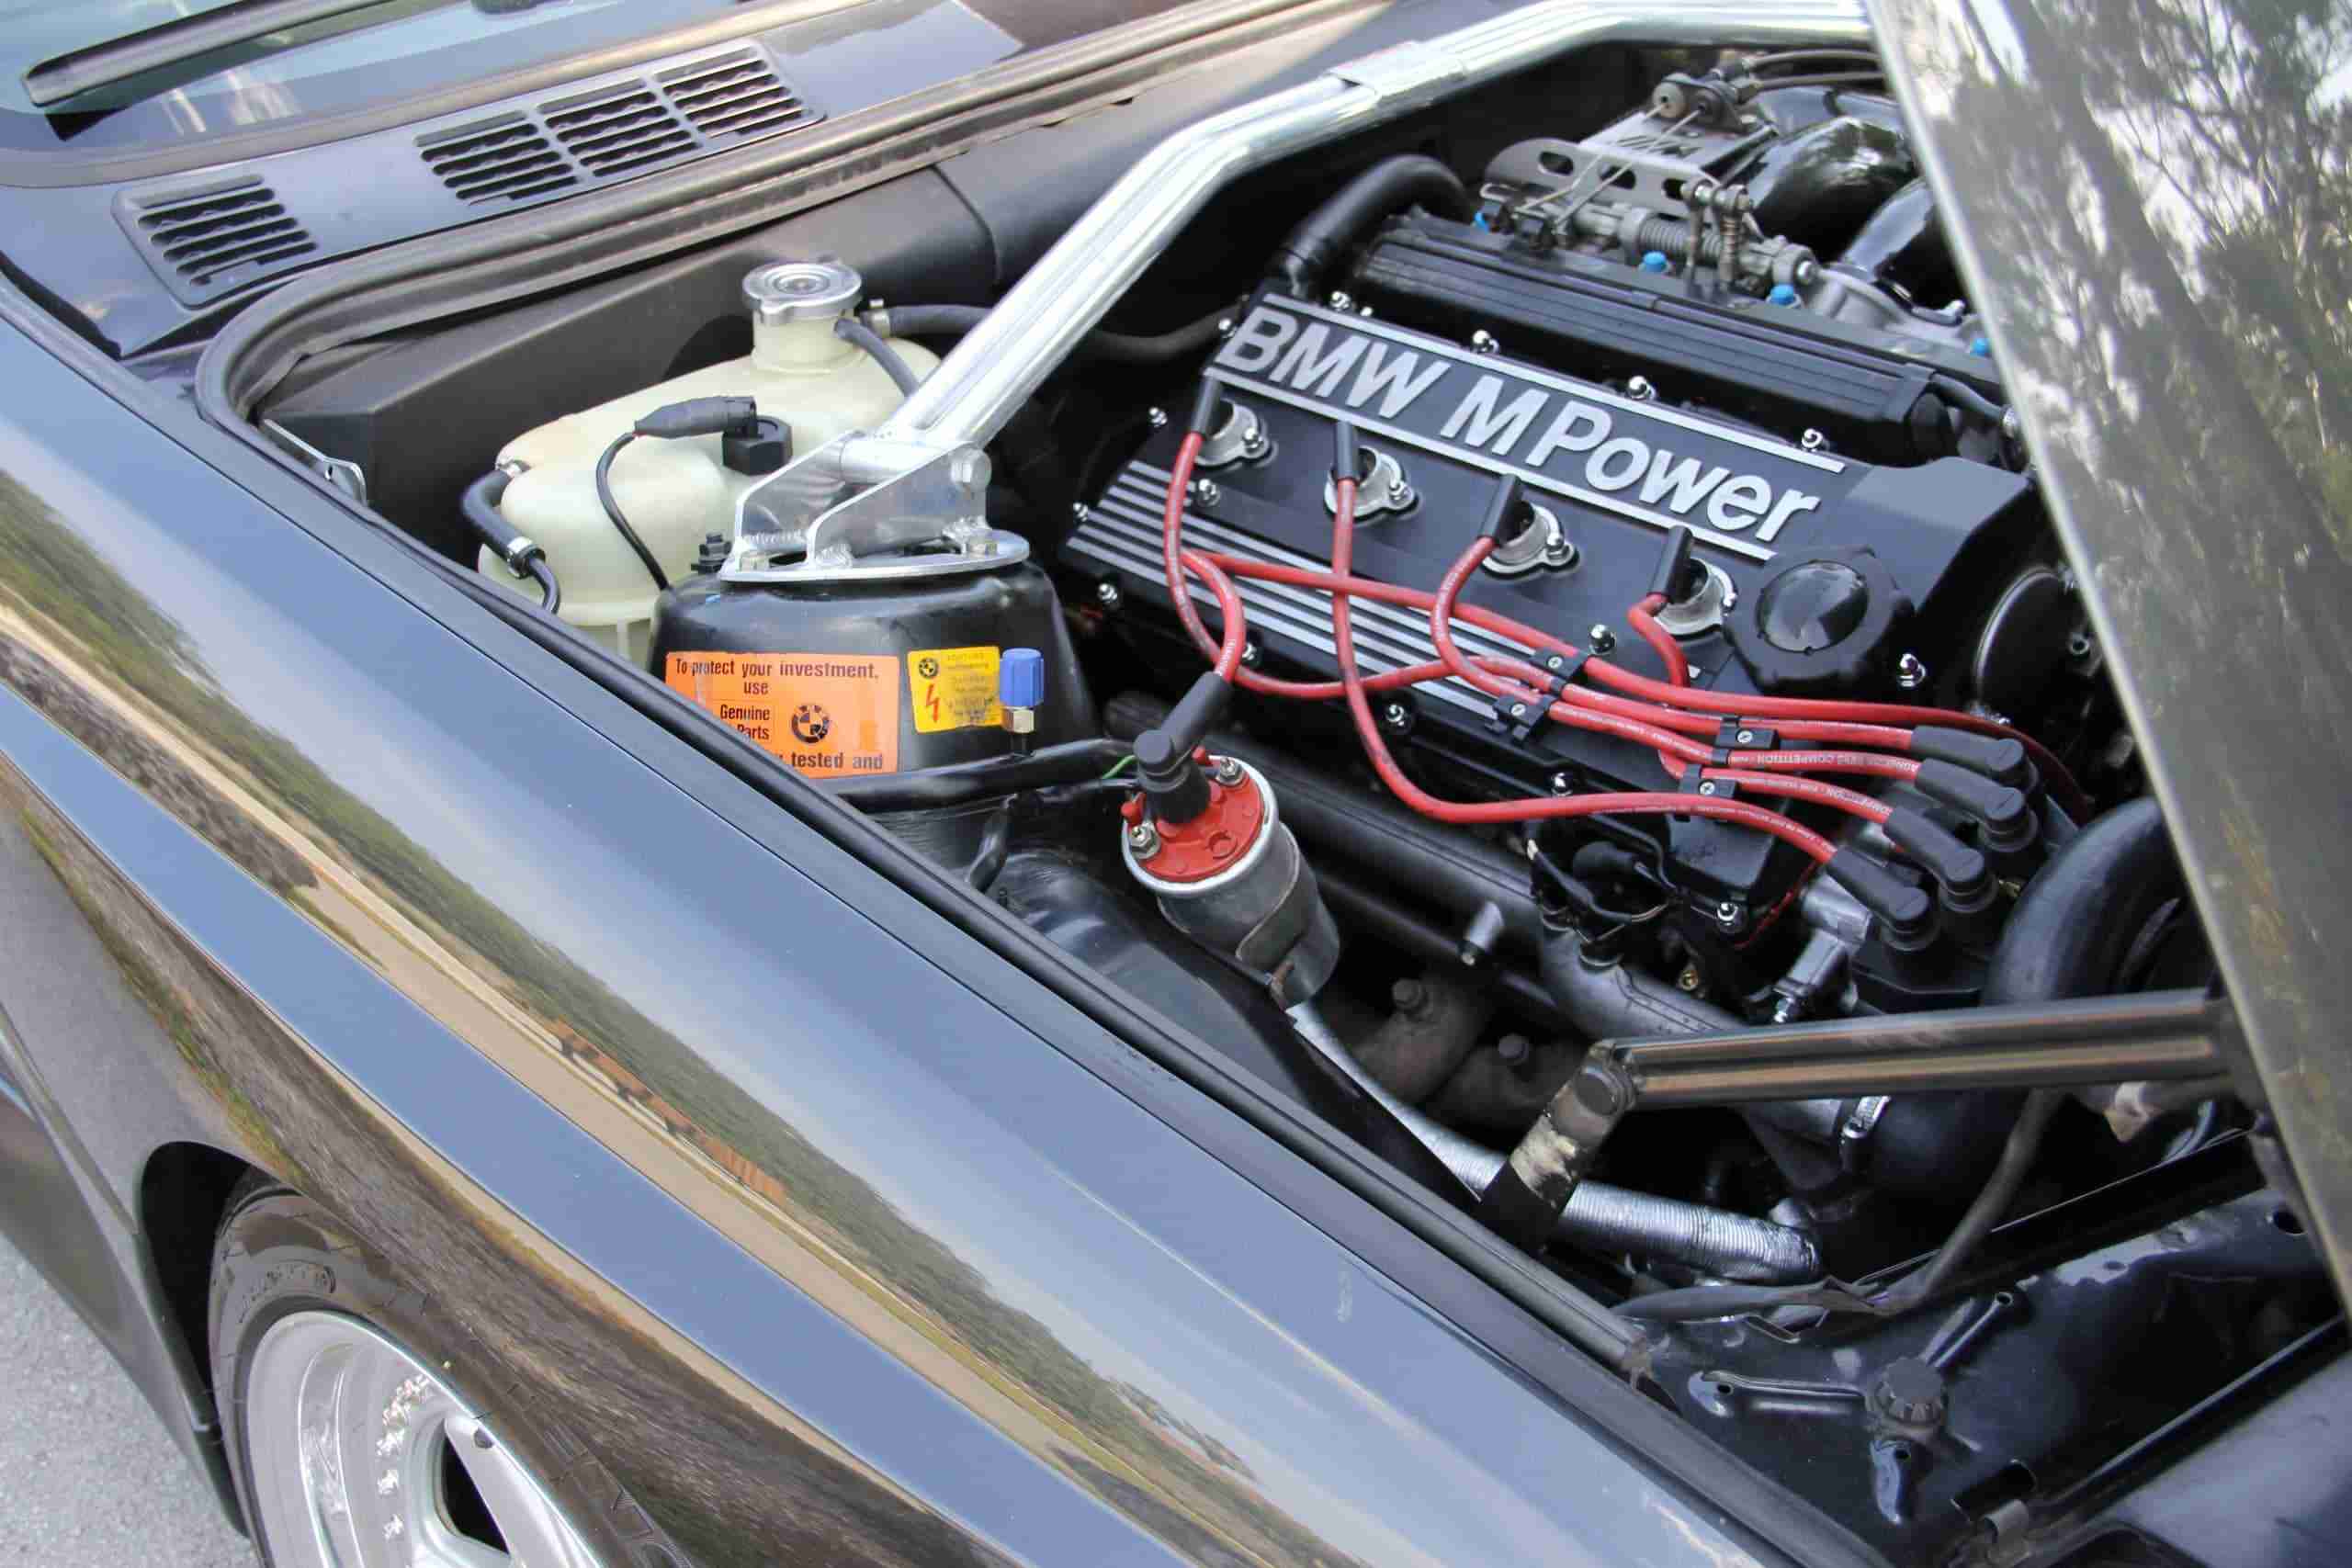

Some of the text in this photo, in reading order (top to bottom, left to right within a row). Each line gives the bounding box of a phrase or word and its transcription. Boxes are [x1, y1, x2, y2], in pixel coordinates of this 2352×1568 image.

[1213, 304, 1450, 421] BMW
[675, 658, 687, 674] To
[691, 659, 735, 676] protect
[741, 662, 773, 679] your
[743, 681, 769, 695] use
[719, 704, 771, 721] Genuine
[791, 752, 844, 769] tested
[853, 754, 883, 770] and
